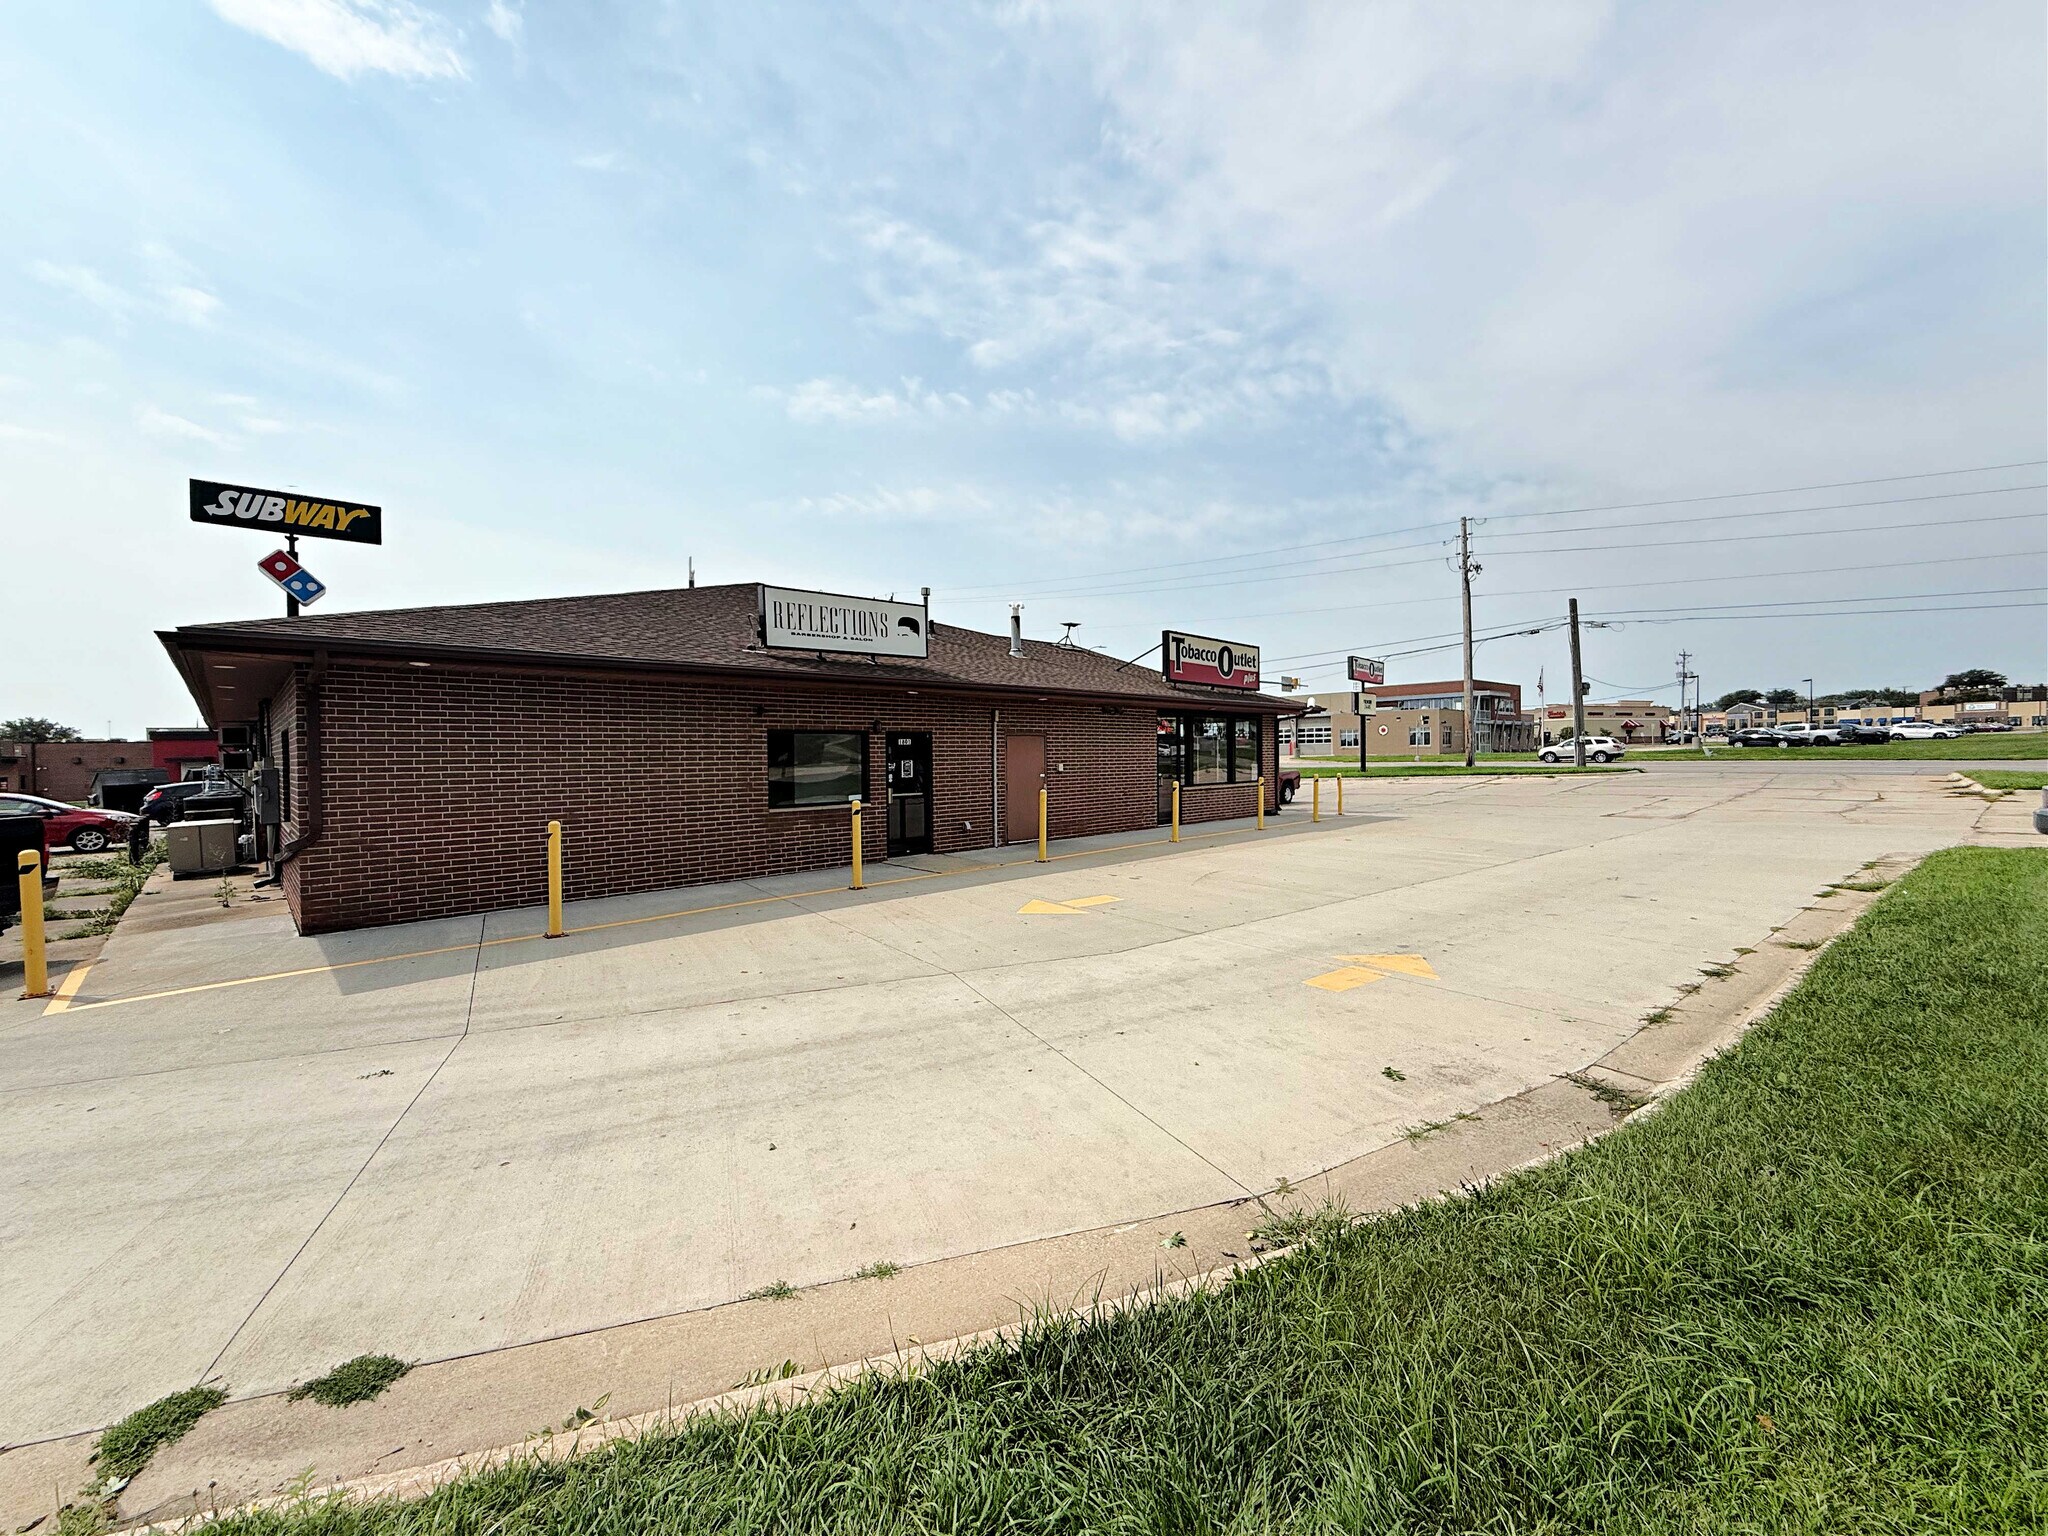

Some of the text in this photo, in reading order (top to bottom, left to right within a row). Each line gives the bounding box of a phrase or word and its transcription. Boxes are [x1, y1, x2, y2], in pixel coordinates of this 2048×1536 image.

[203, 490, 371, 531] SUBWAY
[773, 601, 888, 638] REFLECTIONS
[1172, 636, 1257, 678] Tobacco Outlet
[1243, 673, 1257, 685] plus
